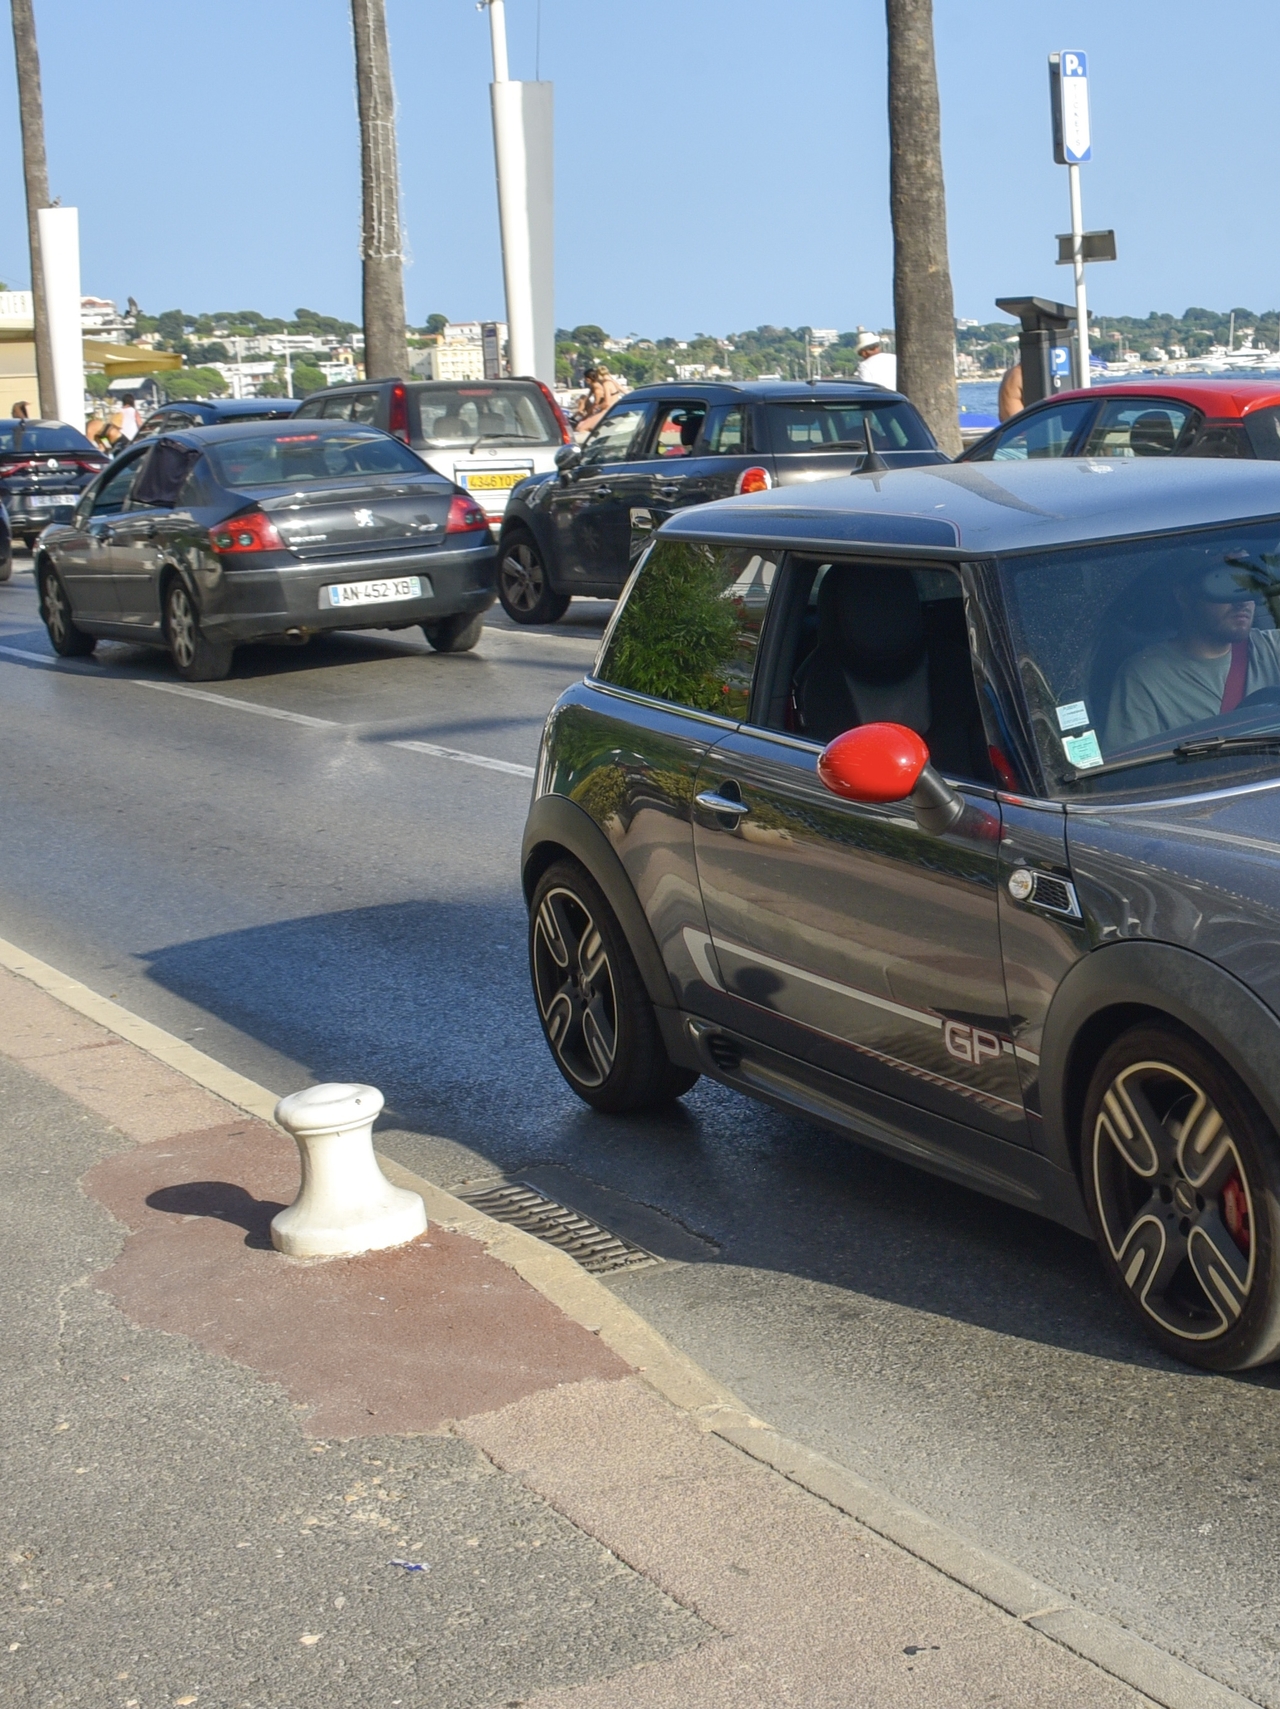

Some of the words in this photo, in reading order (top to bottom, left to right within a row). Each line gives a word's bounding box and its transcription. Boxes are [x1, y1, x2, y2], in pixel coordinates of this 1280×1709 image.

[1065, 54, 1079, 76] P
[1052, 349, 1067, 371] P
[1053, 375, 1062, 388] 6
[945, 1020, 1000, 1065] GP
